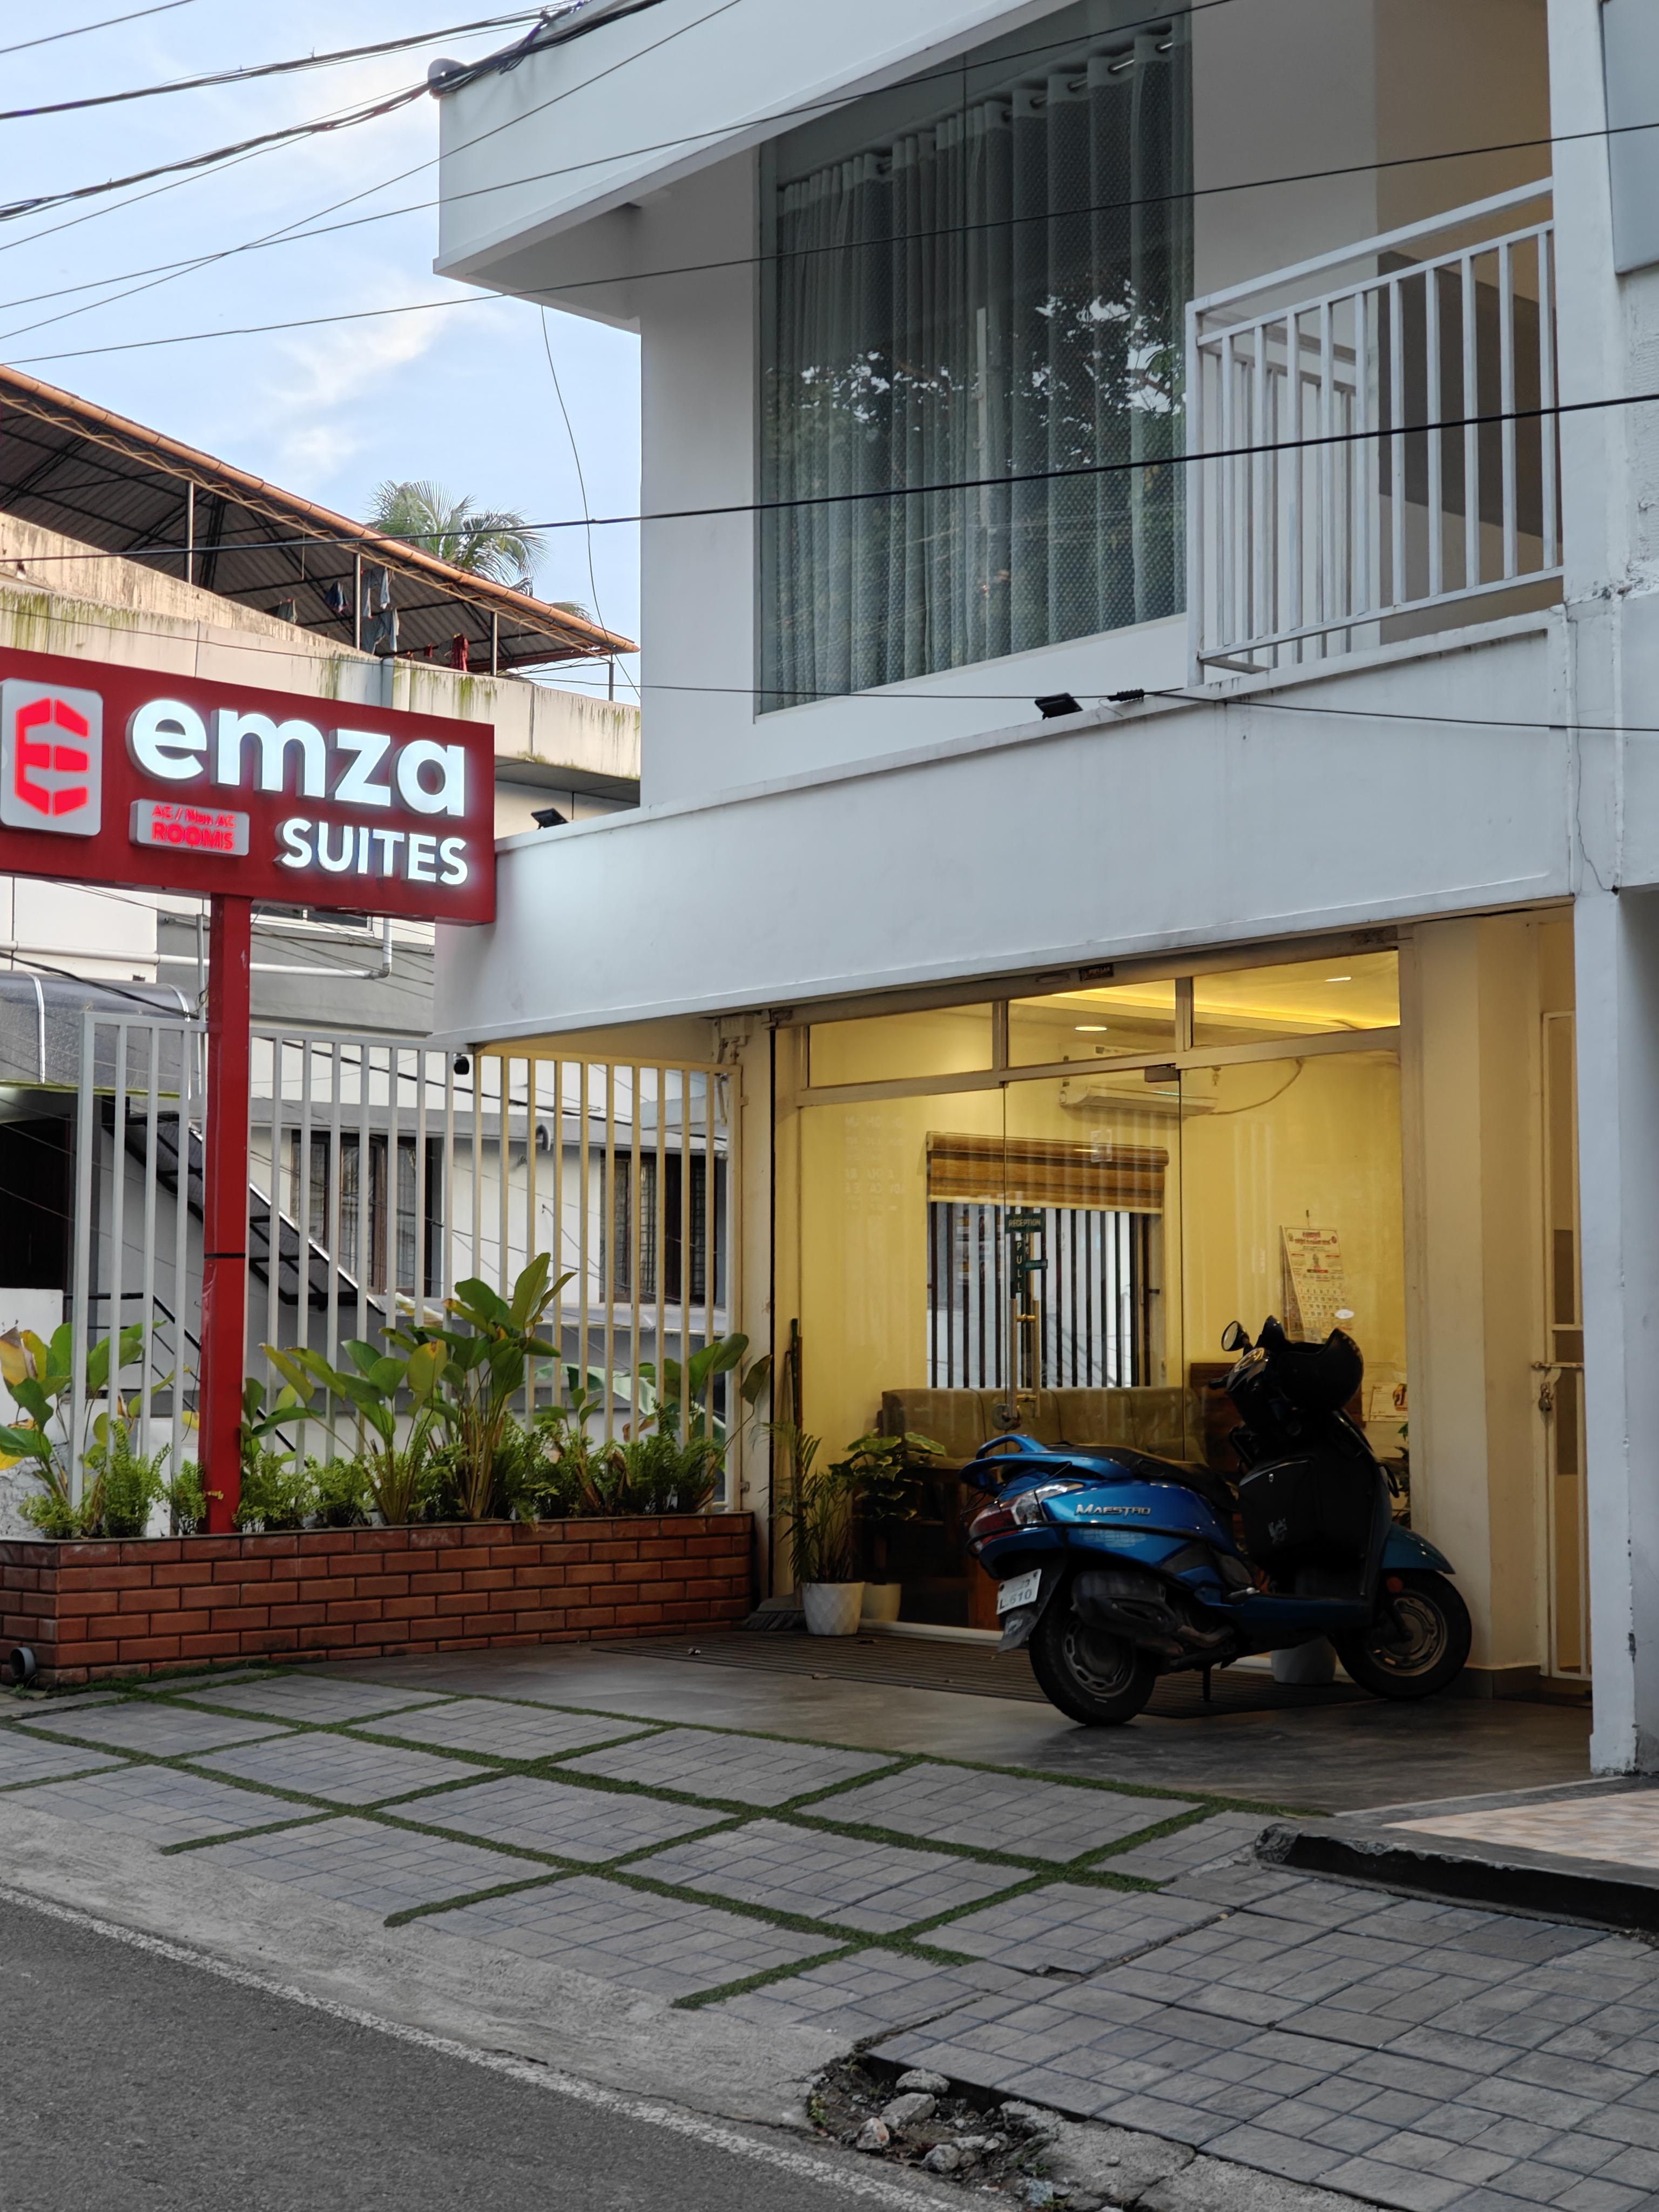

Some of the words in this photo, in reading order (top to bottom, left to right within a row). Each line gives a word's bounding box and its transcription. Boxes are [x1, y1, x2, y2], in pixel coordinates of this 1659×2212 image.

[128, 699, 466, 817] emza
[152, 804, 173, 819] AC
[186, 808, 212, 825] Non
[216, 812, 235, 828] AC
[152, 821, 234, 851] ROOMS
[278, 818, 469, 886] SUITES
[1008, 1218, 1041, 1227] RECEPTION
[1075, 1503, 1151, 1516] MAESTRO
